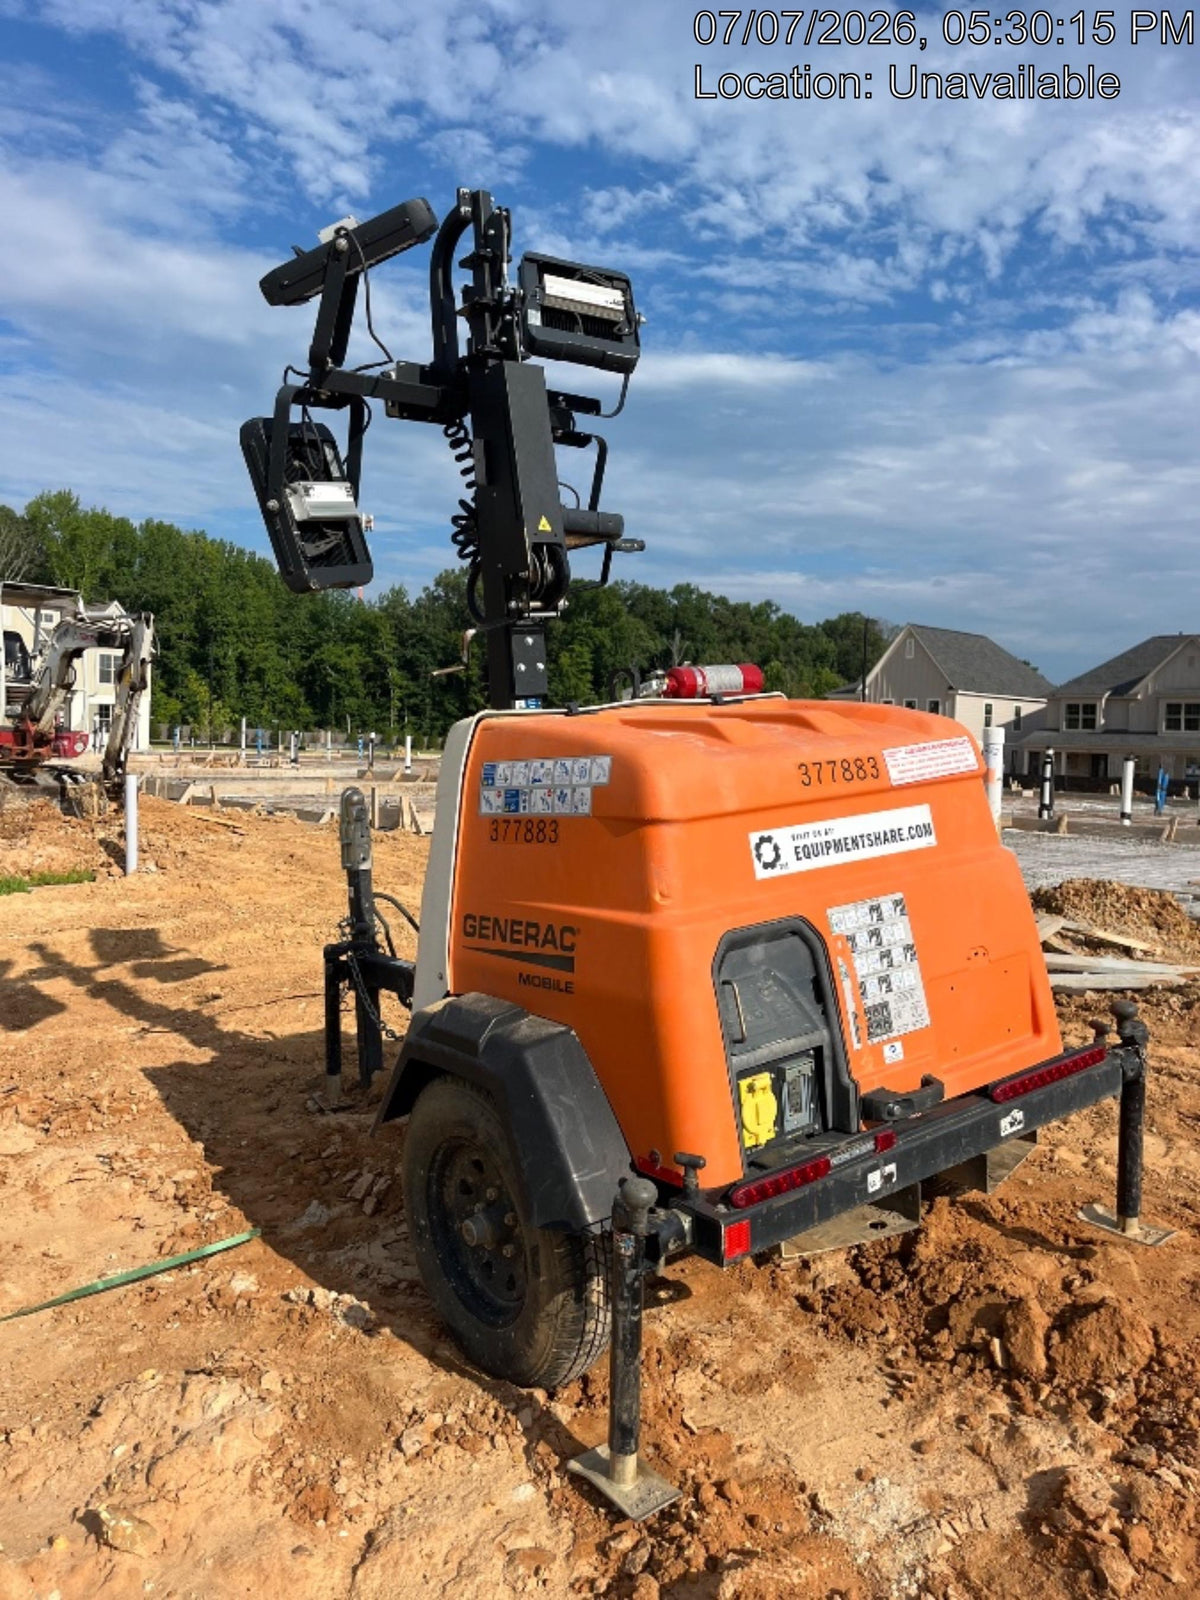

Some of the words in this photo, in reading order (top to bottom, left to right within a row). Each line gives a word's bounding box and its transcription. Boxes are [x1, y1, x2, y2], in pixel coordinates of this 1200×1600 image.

[798, 756, 880, 787] 377883
[489, 819, 559, 844] 377883
[794, 822, 933, 861] EQUIPMENTSHARE.COM
[463, 913, 576, 952] GENERAC
[518, 972, 575, 995] MOBILE
